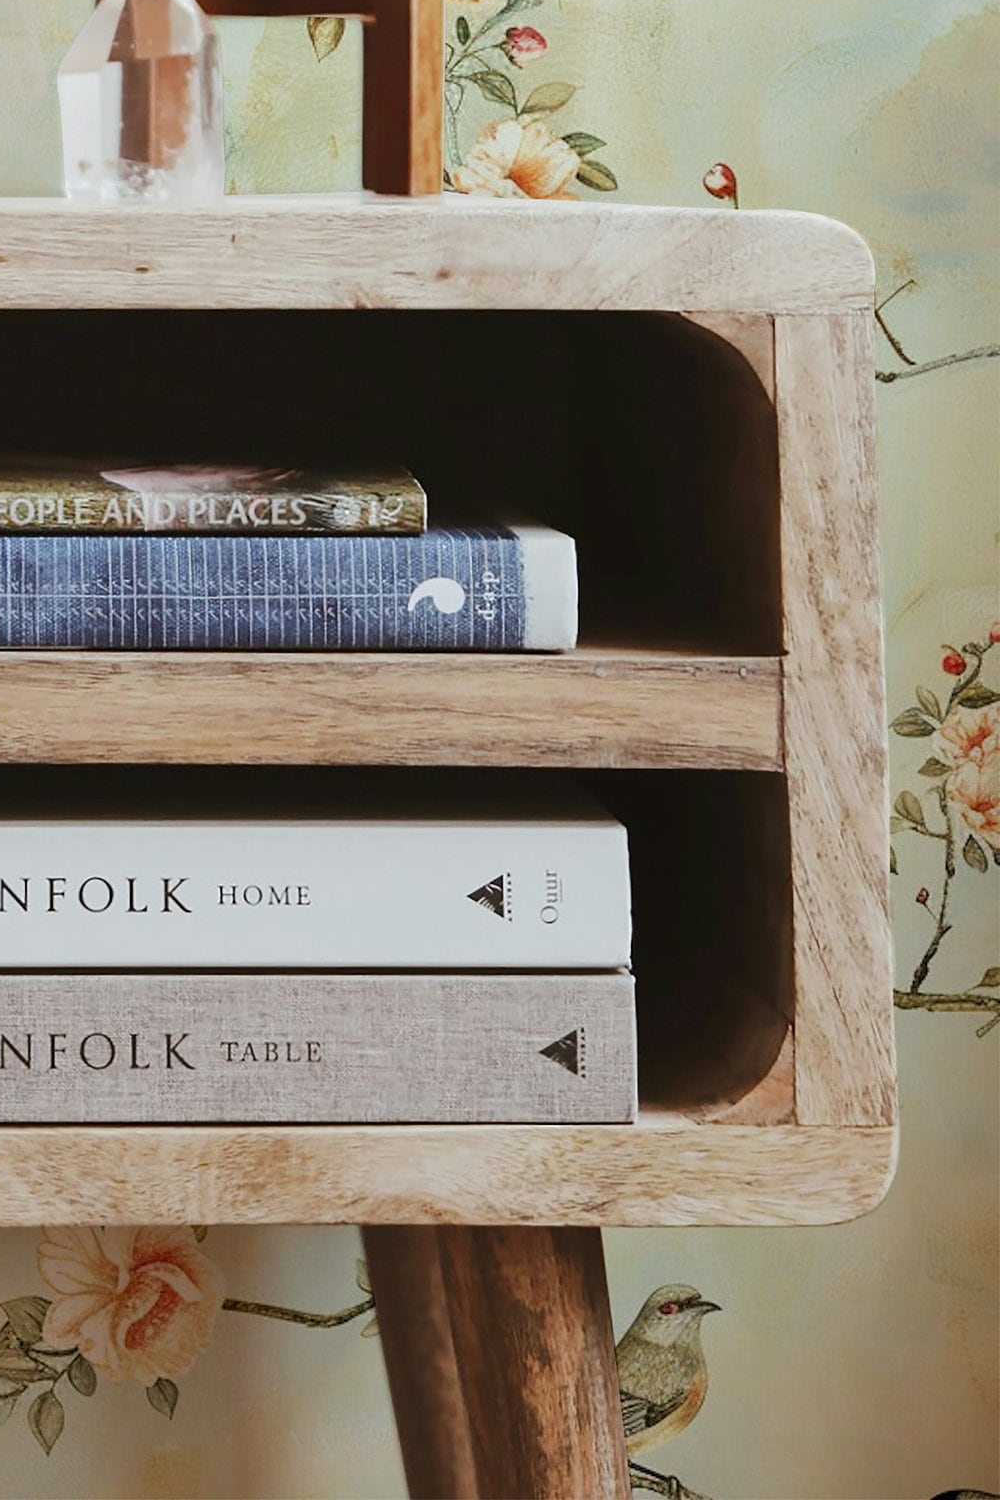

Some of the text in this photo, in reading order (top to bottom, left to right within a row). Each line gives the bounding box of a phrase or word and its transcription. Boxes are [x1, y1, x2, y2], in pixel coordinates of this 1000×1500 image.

[101, 497, 176, 527] AND
[188, 497, 307, 527] PLACES
[217, 884, 312, 907] HOME
[539, 868, 559, 925] Ouur
[219, 1040, 323, 1064] TABLE
